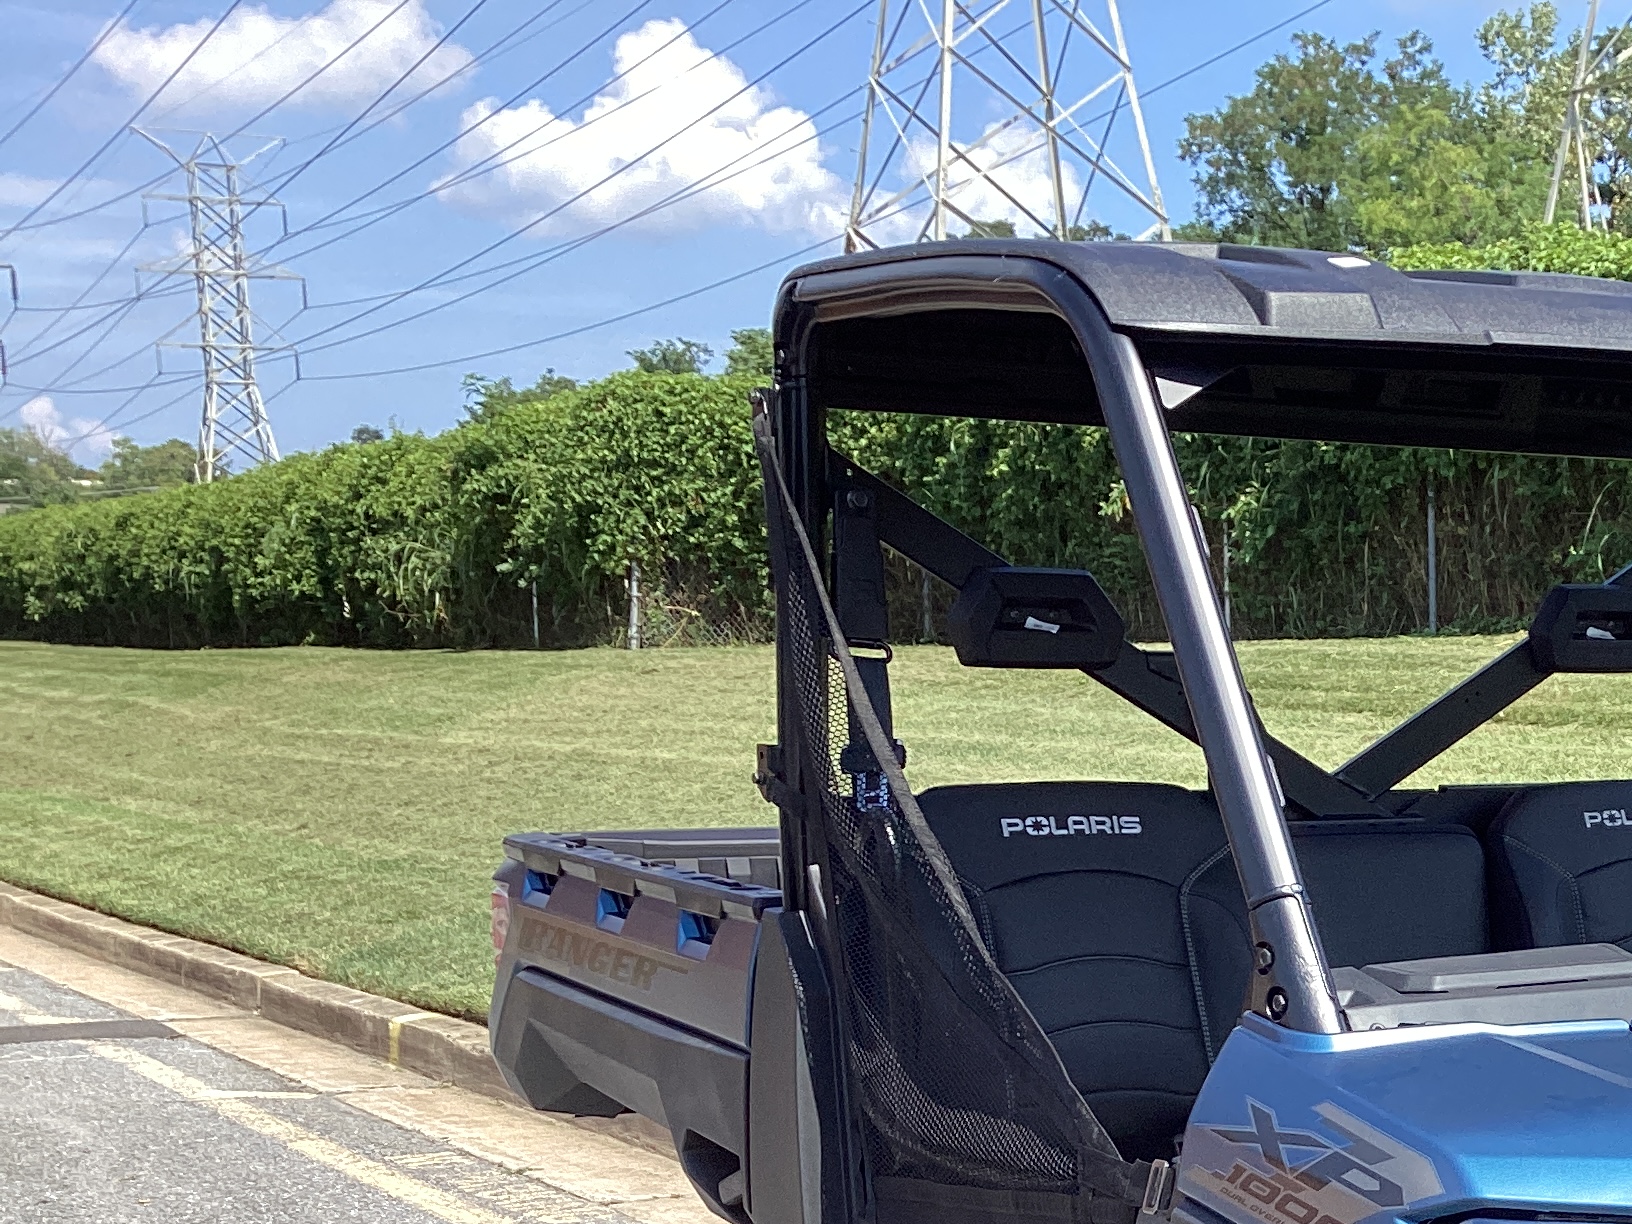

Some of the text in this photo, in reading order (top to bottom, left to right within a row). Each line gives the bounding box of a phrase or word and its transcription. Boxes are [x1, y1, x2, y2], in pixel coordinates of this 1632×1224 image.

[1001, 814, 1143, 838] POLARIS
[518, 917, 658, 991] RANGER
[1209, 1098, 1406, 1209] XP
[1219, 1186, 1248, 1207] DUAL
